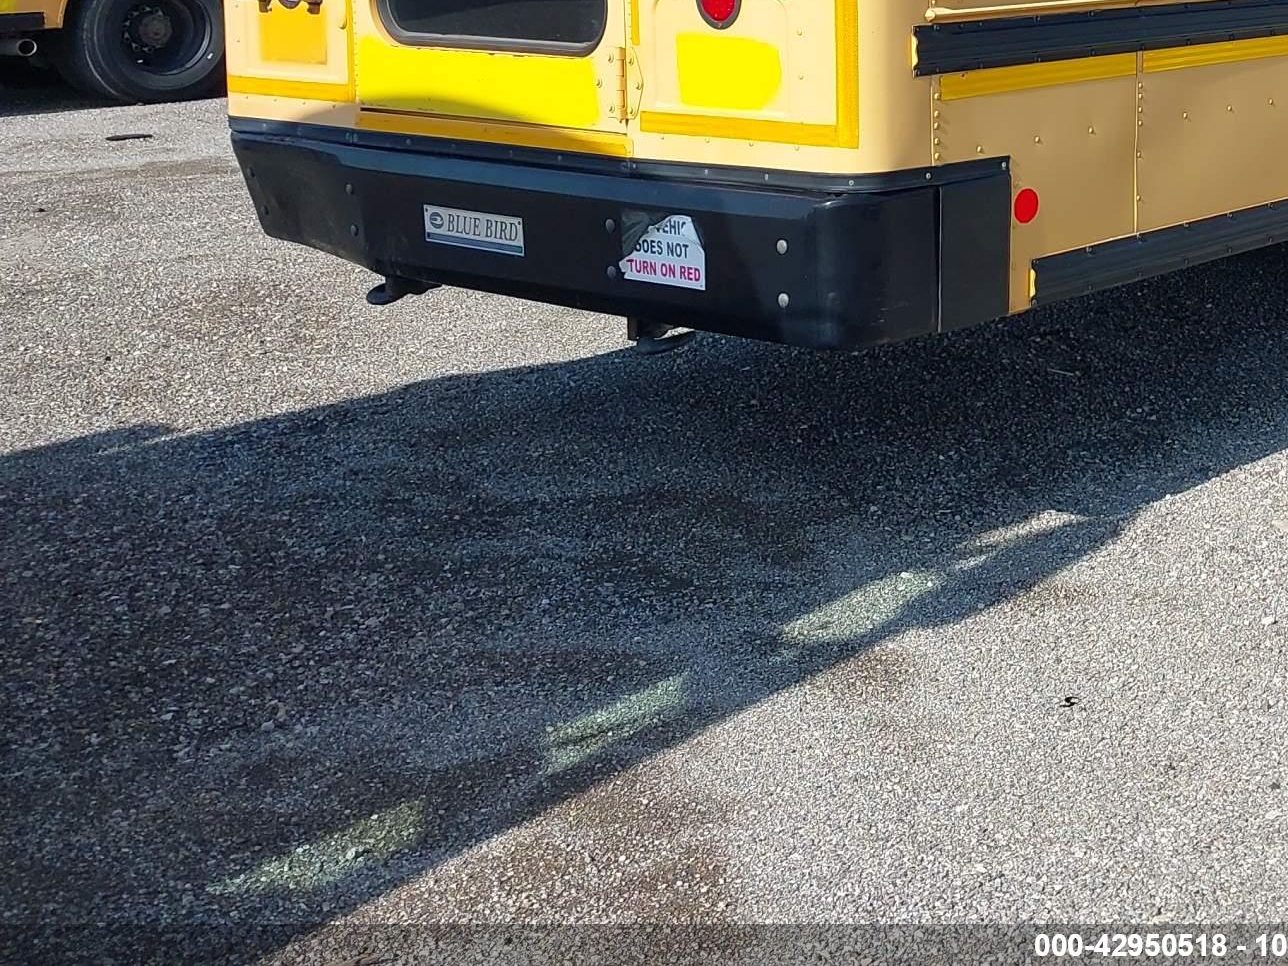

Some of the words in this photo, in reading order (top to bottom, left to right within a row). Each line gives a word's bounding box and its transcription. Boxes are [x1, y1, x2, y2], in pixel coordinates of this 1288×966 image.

[446, 213, 481, 237] BLUE
[485, 219, 518, 242] BIRD
[666, 241, 689, 259] NOT
[626, 258, 657, 276] TURN
[660, 263, 676, 279] ON
[679, 265, 701, 282] RED
